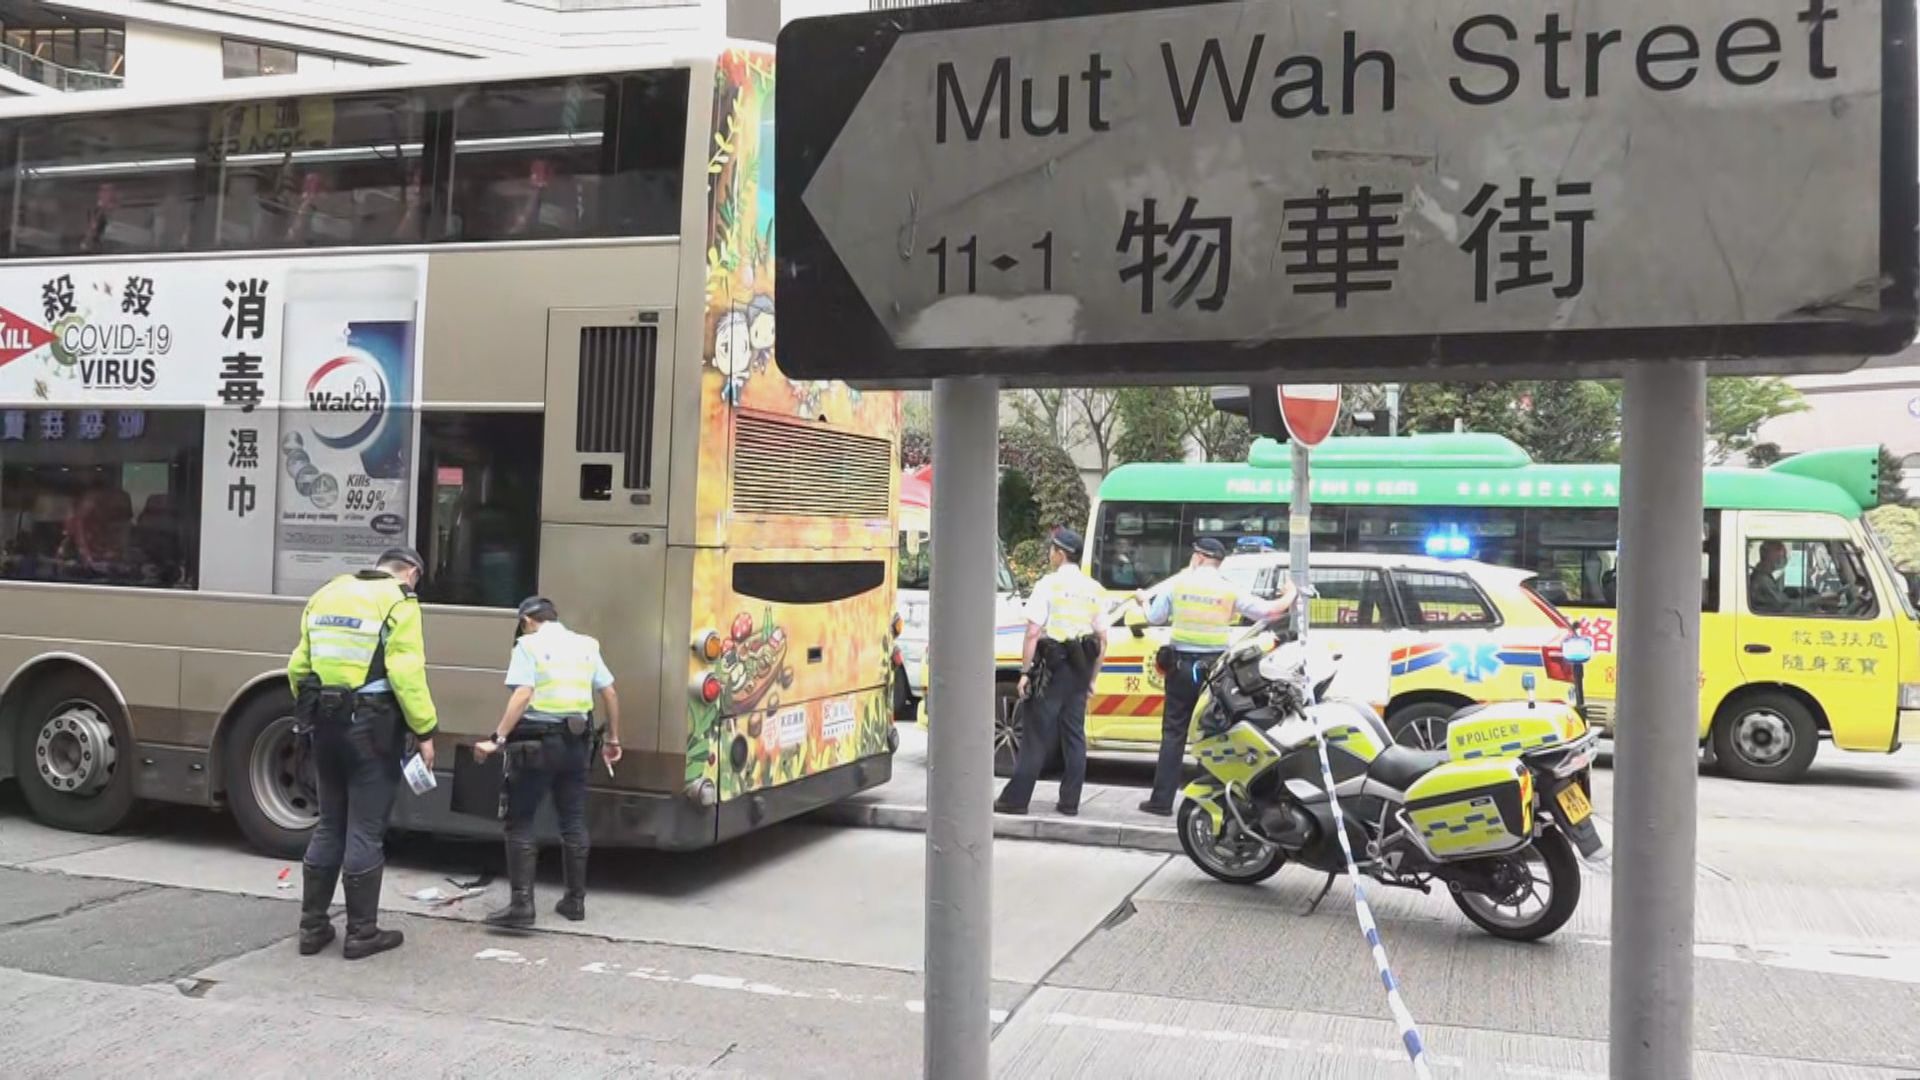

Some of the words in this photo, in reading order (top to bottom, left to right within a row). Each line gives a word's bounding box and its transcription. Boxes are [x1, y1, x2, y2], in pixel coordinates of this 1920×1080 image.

[936, 53, 1112, 144] Mut
[1160, 30, 1396, 128] Wah
[1449, 0, 1839, 105] Street
[1115, 177, 1595, 314] 物華街
[64, 323, 171, 353] COVID-19
[80, 358, 157, 385] VIRUS
[217, 278, 269, 517] 消毒濕巾
[309, 391, 380, 412] Walch
[346, 474, 371, 488] Kills
[345, 489, 385, 511] 99.9%
[1465, 727, 1509, 745] POLICE
